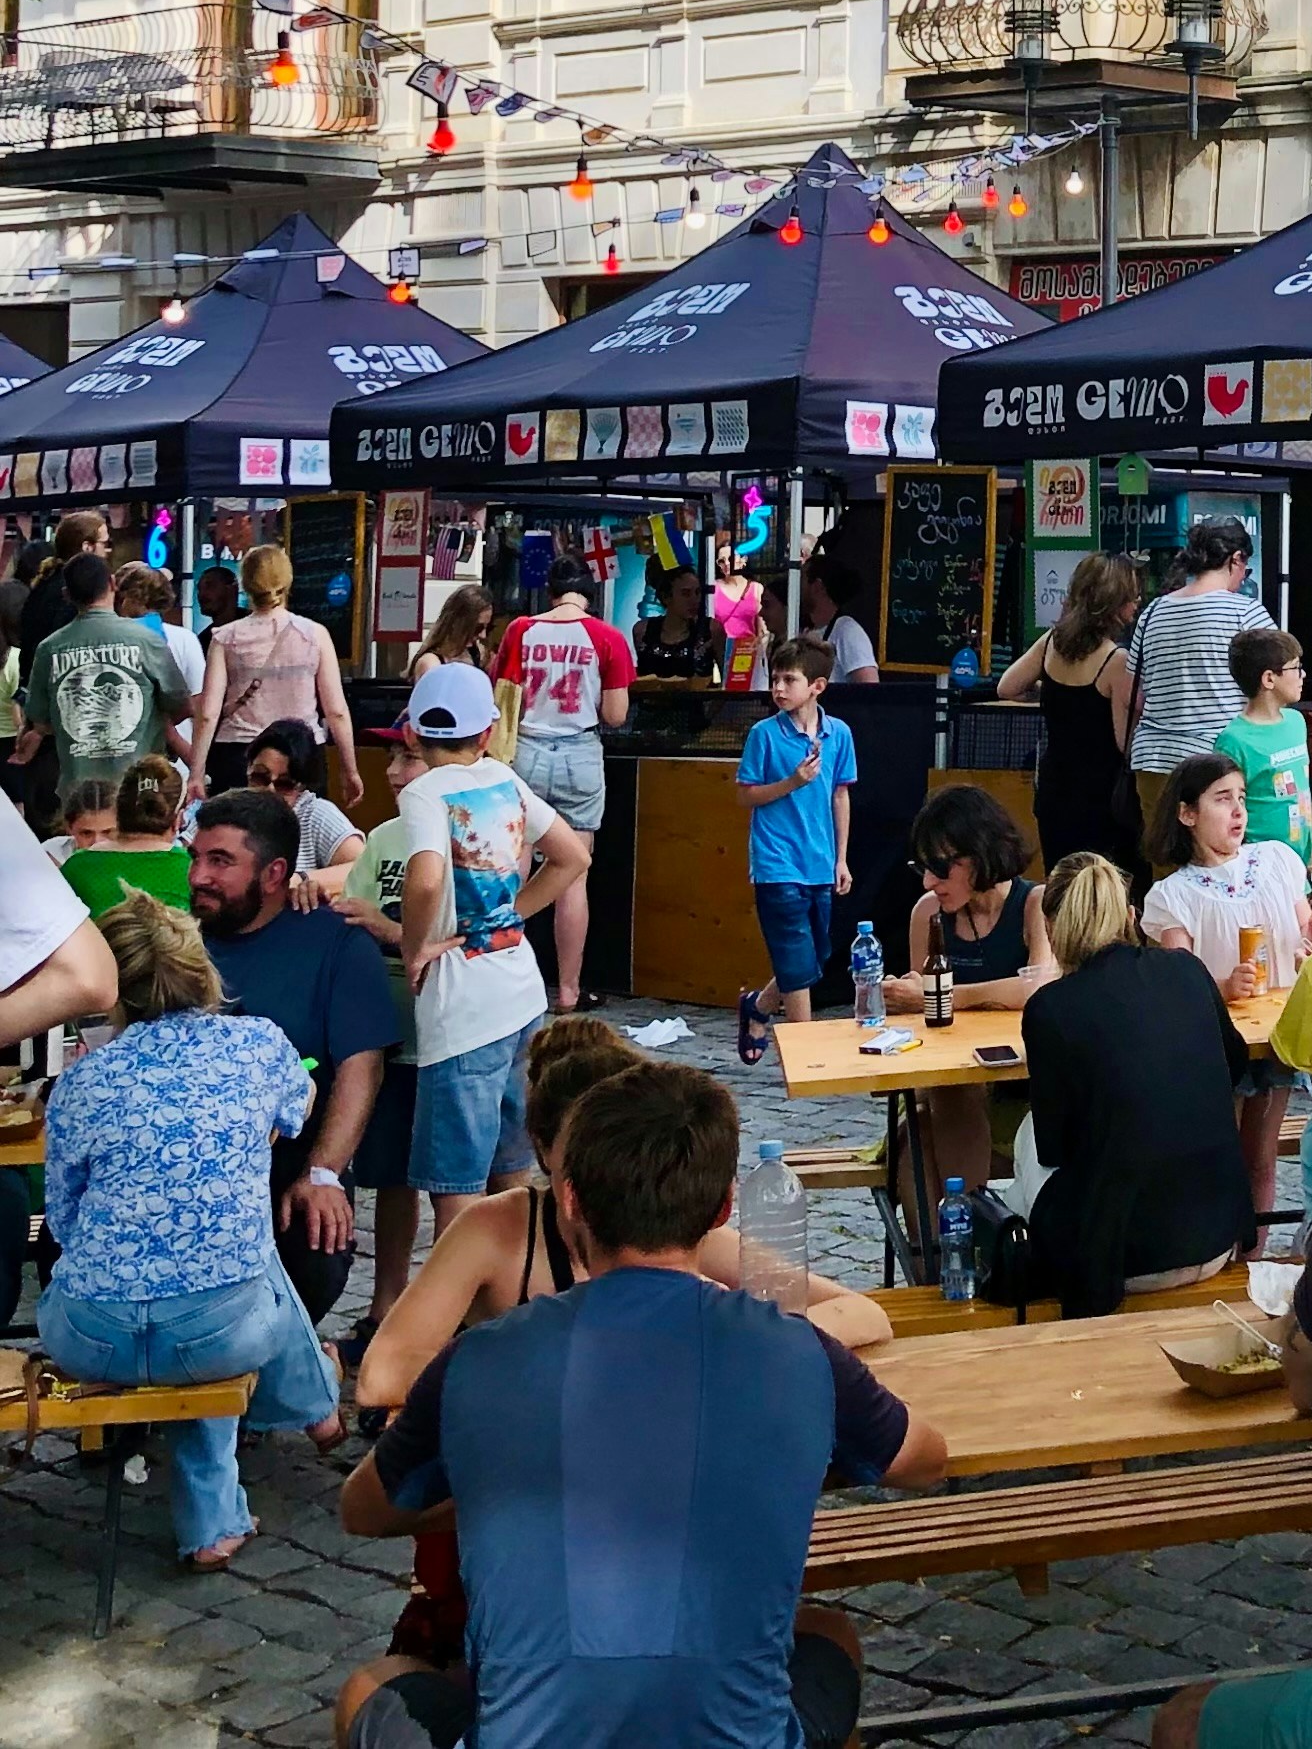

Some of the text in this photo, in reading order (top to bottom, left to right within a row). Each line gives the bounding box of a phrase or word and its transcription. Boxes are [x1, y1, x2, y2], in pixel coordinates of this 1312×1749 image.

[588, 324, 699, 353] GEMO
[65, 372, 153, 395] GEMO
[1076, 373, 1190, 421] GEMO
[419, 421, 496, 459] GEMO
[147, 525, 168, 569] 6
[734, 504, 773, 556] 5
[51, 644, 143, 684] ADVENTURE
